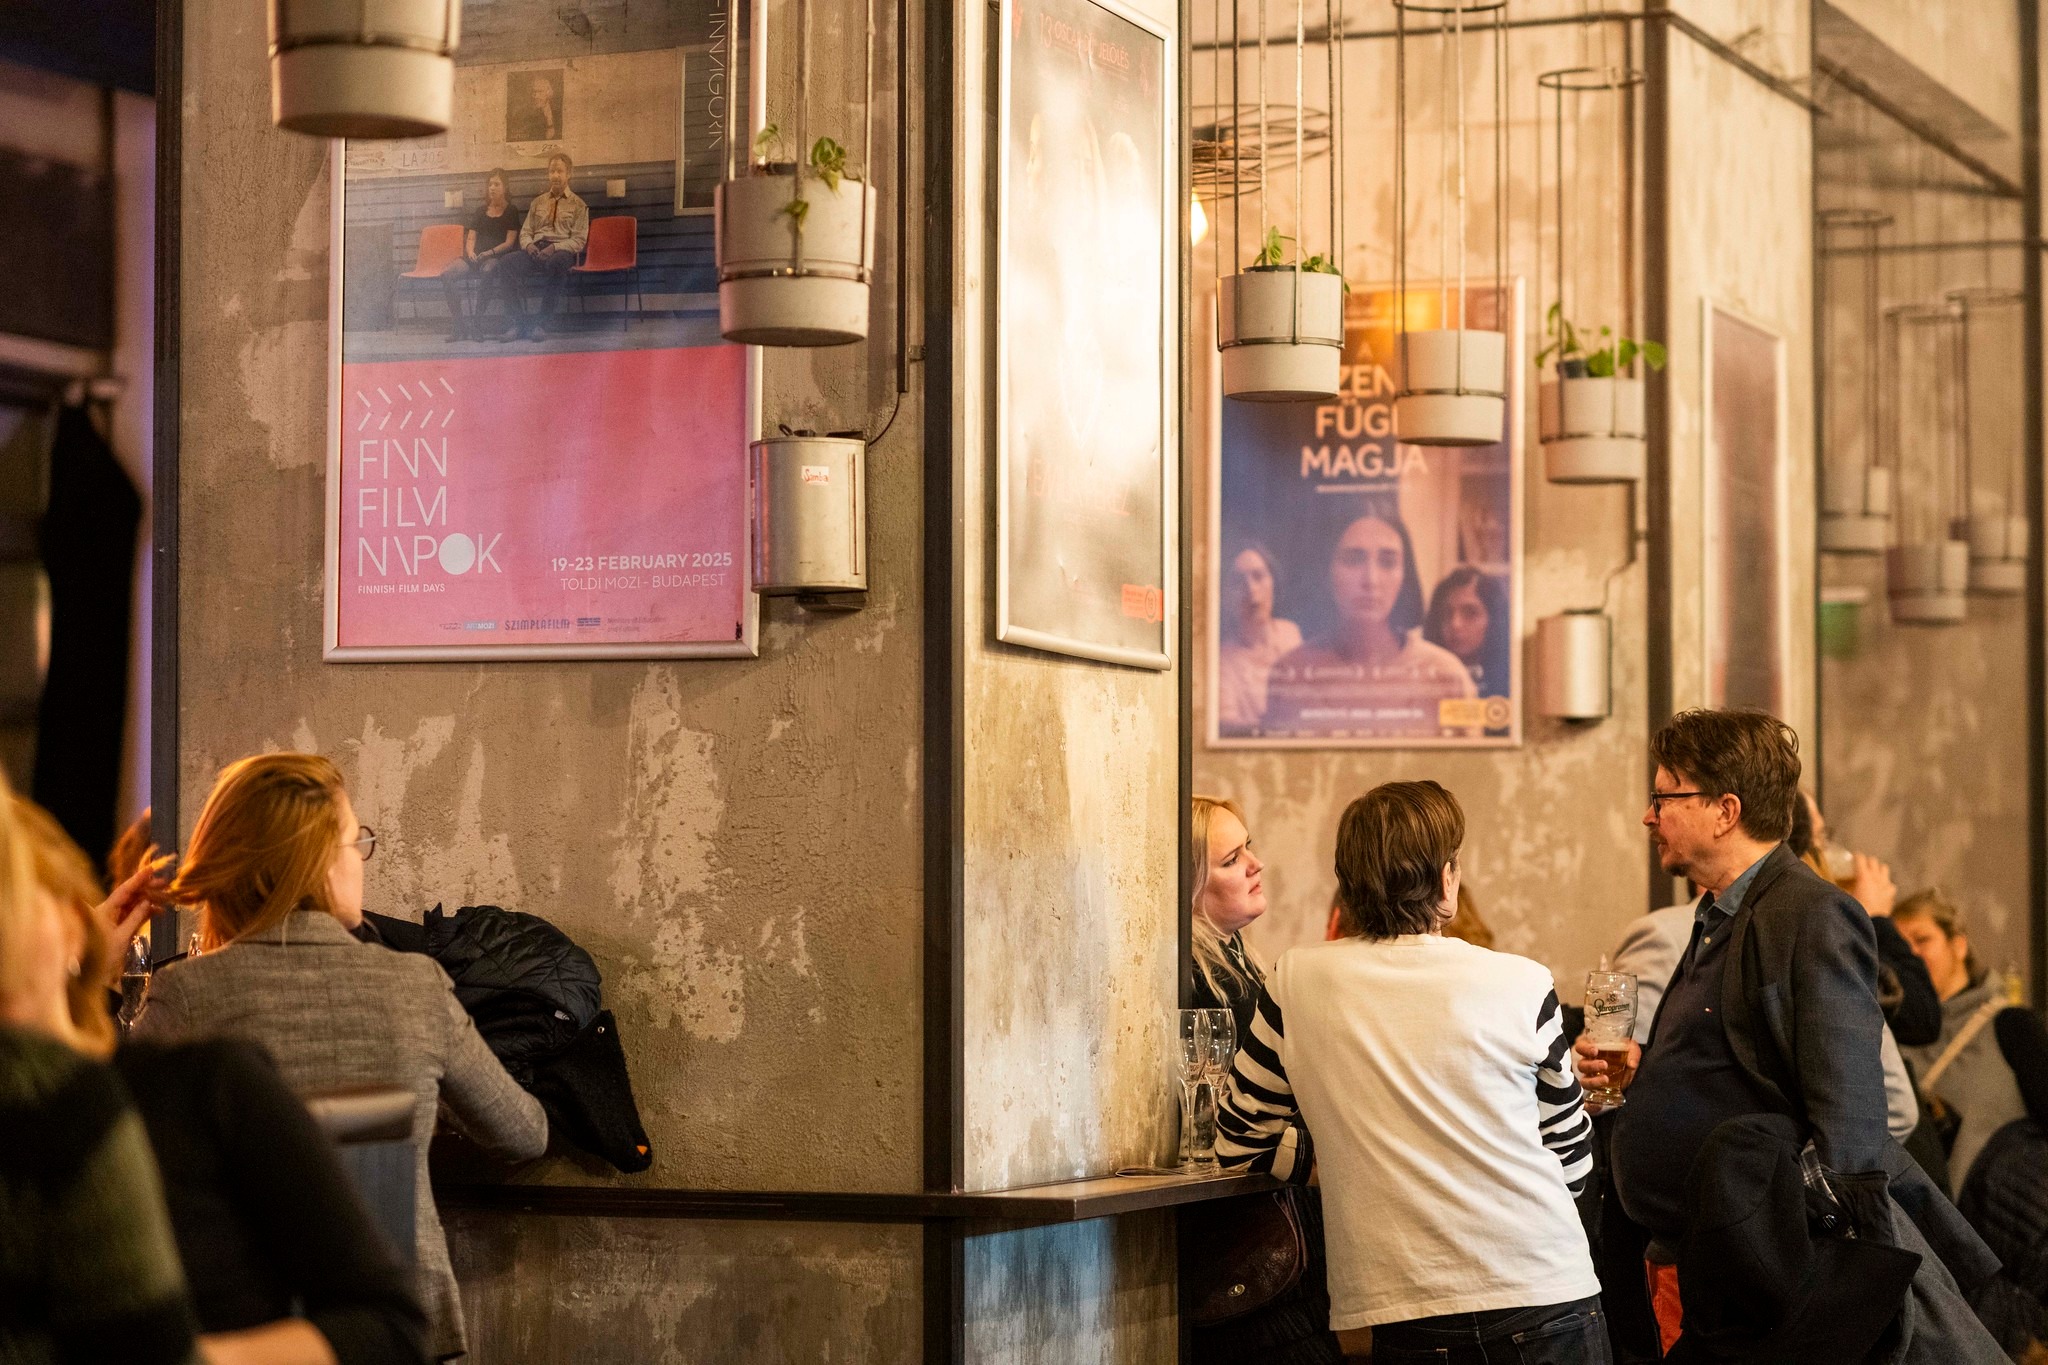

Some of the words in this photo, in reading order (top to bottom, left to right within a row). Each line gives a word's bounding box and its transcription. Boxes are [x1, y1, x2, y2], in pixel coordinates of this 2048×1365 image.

[359, 437, 447, 480] FINN
[1301, 443, 1429, 478] MAGJA
[358, 485, 447, 528] FILM
[551, 556, 594, 571] 19-23
[598, 553, 689, 571] FEBRUARY
[692, 552, 733, 568] 2025
[358, 584, 395, 594] FINNISH
[399, 583, 420, 593] FILM
[423, 583, 446, 593] DAYS
[560, 577, 601, 590] TOLDI
[605, 576, 640, 590] MOZI
[652, 573, 727, 588] BUDAPEST
[504, 618, 571, 631] SZIMPLAFILM
